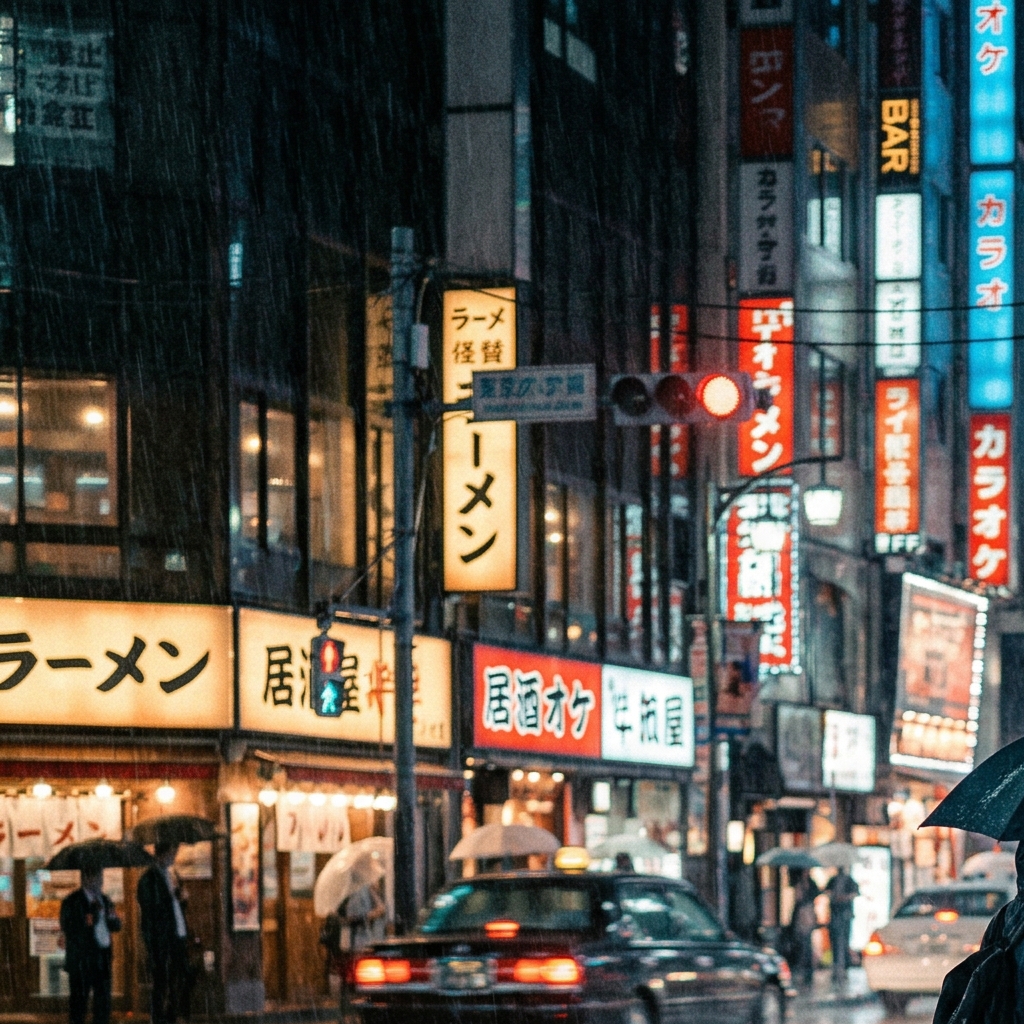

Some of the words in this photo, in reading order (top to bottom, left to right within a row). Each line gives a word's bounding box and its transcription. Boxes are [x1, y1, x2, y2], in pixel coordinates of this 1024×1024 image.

[881, 98, 910, 174] BAR
[975, 193, 1008, 312] カラオ
[451, 307, 505, 331] ラーメ
[972, 423, 1008, 578] カラオケ
[0, 632, 210, 694] ラーメン
[263, 644, 360, 713] 居屋
